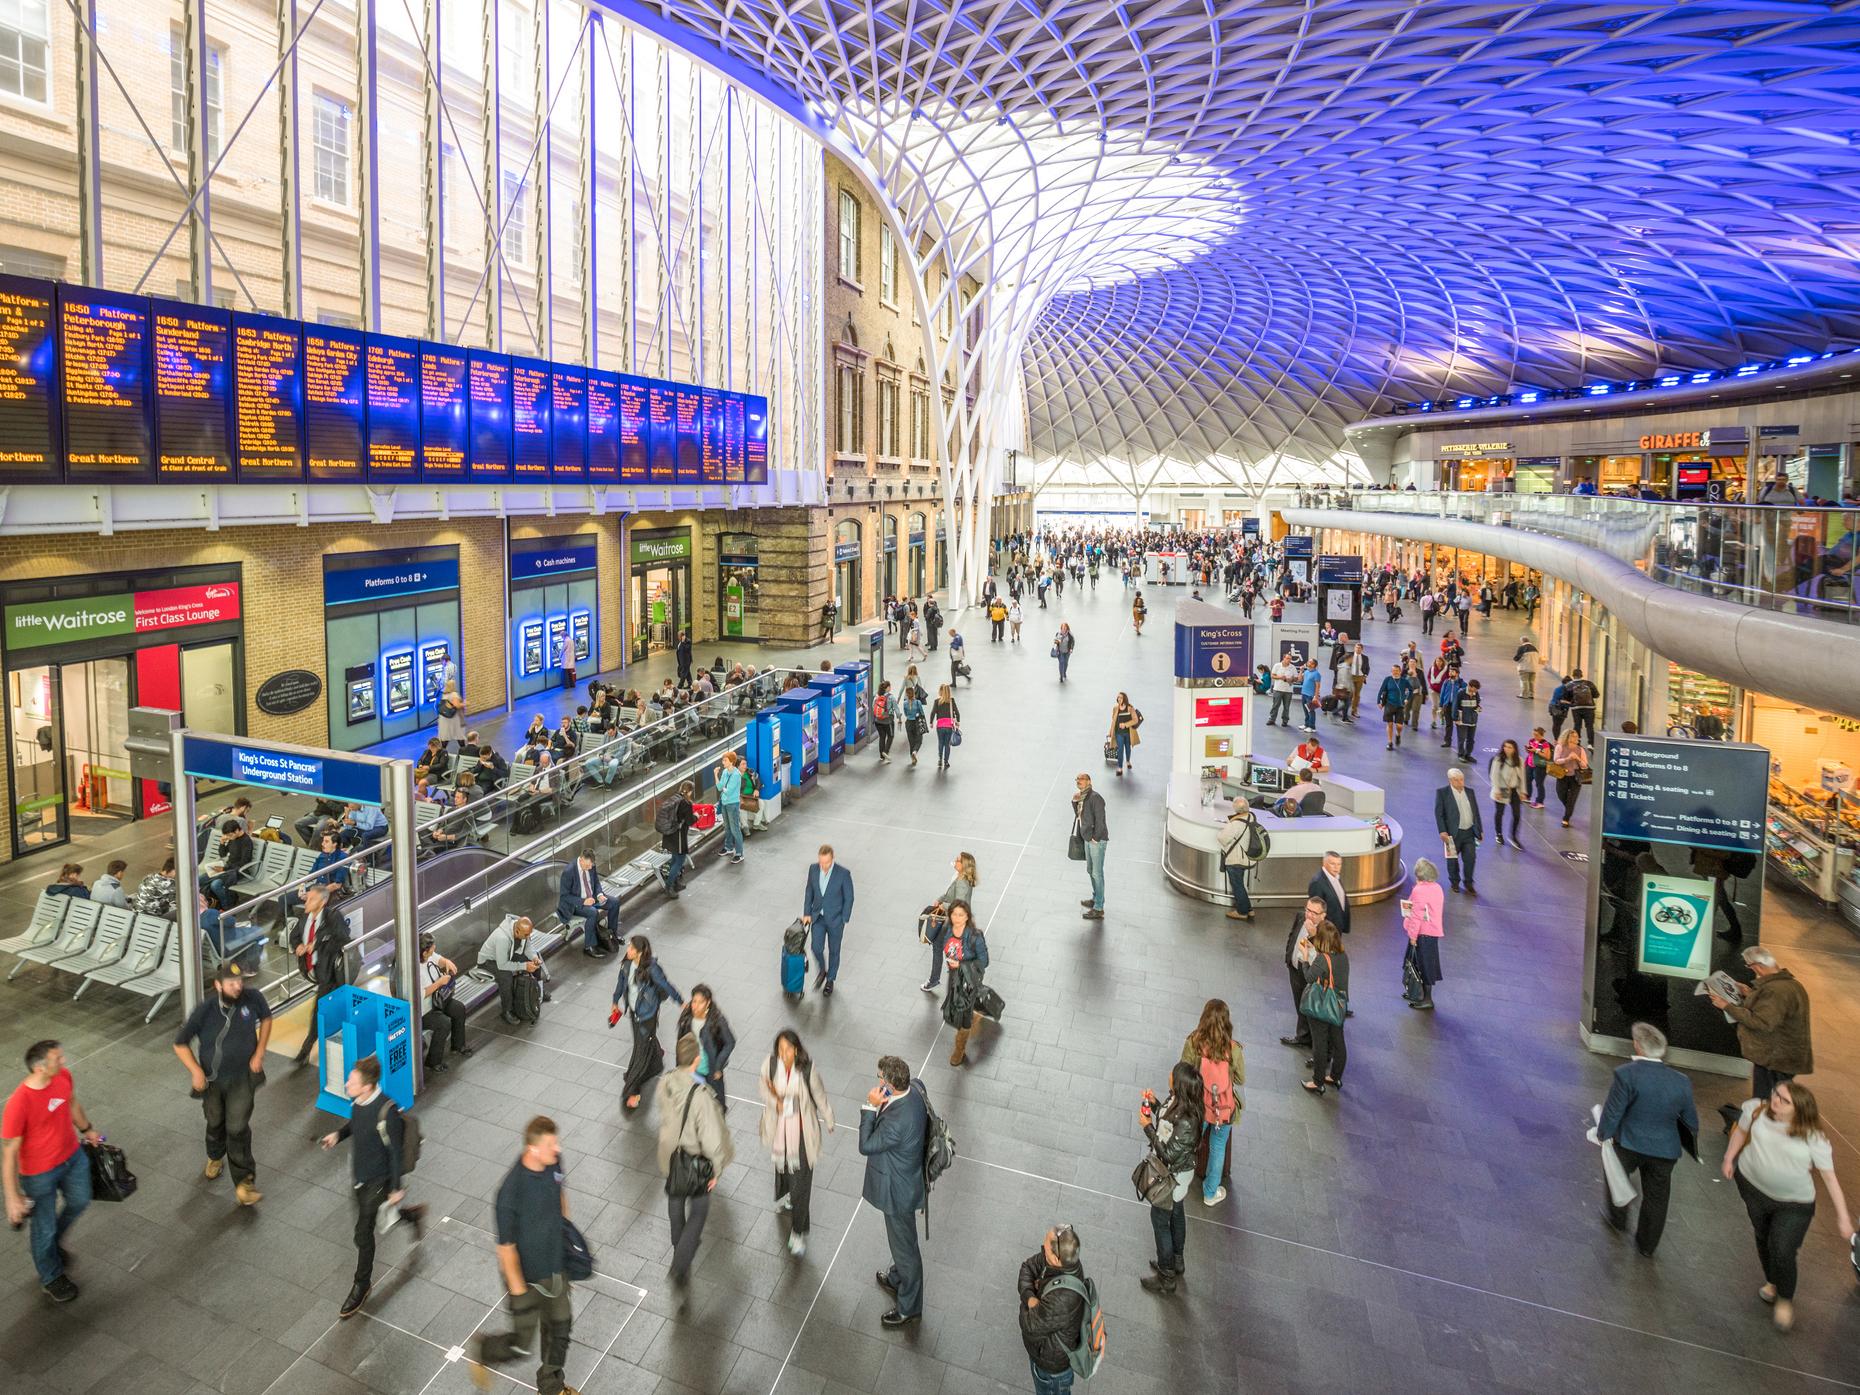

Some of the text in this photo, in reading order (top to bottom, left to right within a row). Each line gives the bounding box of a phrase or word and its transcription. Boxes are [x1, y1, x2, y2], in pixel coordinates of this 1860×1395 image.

[100, 308, 136, 321] Platform
[64, 313, 126, 330] Peterborough
[187, 320, 218, 332] Platform
[156, 326, 200, 339] Sunderland
[264, 332, 292, 342] Platform
[237, 337, 292, 351] Cambridge North
[330, 340, 354, 350] Platform
[388, 349, 410, 358] Platform
[1640, 432, 1700, 450] GIRAFFE
[70, 454, 139, 464] Great Northern
[161, 456, 215, 466] Grand Central
[262, 458, 292, 466] Northern
[328, 460, 356, 468] Northern
[640, 542, 684, 557] little Waitrose
[544, 556, 576, 566] Cash machines
[365, 578, 394, 588] Platforms
[178, 602, 192, 610] King's
[15, 610, 126, 631] little Waitrose
[136, 608, 220, 628] First Class Lounge
[1200, 629, 1242, 638] King's Cross
[1632, 750, 1680, 760] Underground
[239, 752, 316, 773] King's Cross St Pancras
[1632, 760, 1666, 770] Platforms
[242, 765, 313, 785] Underground Station
[1630, 782, 1654, 791] Dining
[1662, 786, 1689, 794] seating
[1629, 792, 1655, 801] Tickets
[1679, 814, 1714, 824] Platforms
[1676, 825, 1700, 834] Dining
[1709, 829, 1737, 839] seating
[390, 1044, 406, 1064] FREE
